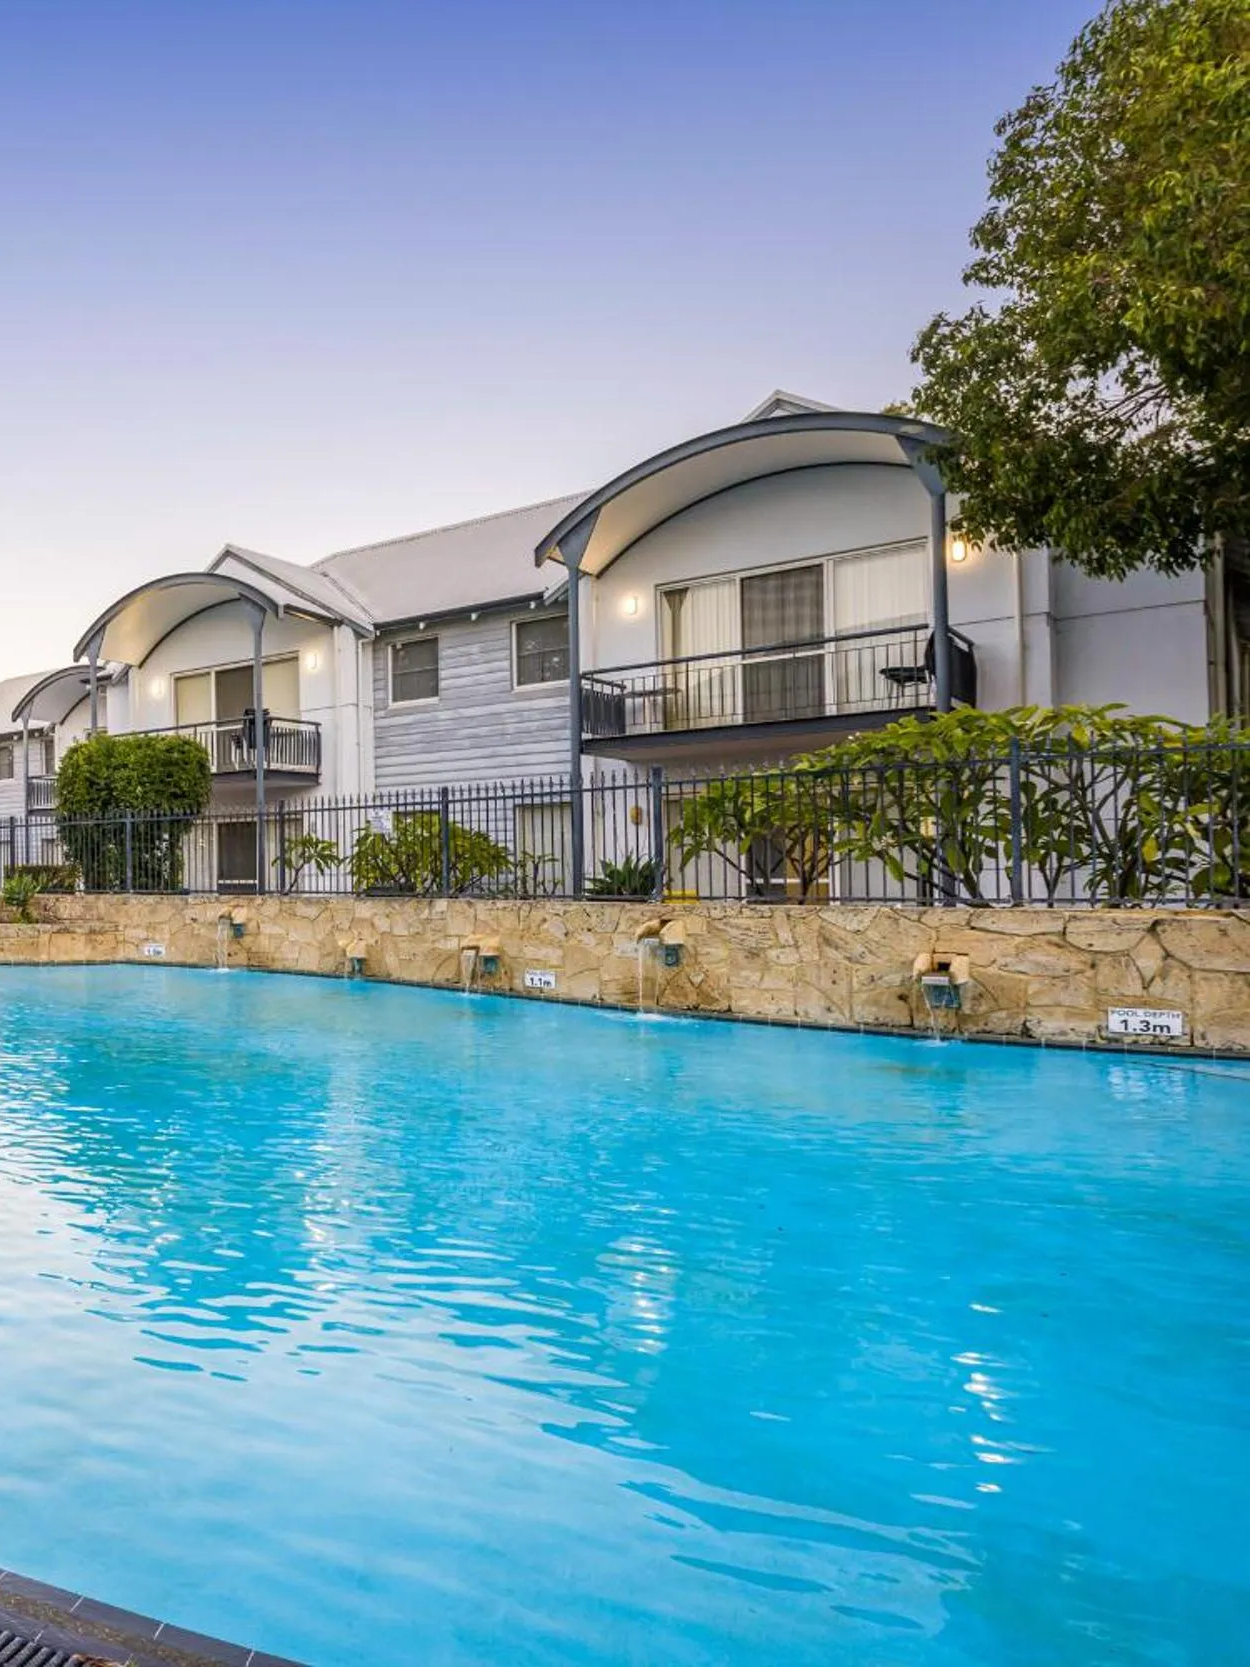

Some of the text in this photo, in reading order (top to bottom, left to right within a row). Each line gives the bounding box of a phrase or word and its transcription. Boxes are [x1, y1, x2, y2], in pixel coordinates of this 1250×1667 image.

[530, 977, 552, 986] 1.1m
[1110, 1009, 1181, 1019] POOL DEPTH
[1120, 1019, 1172, 1034] 1.3m
